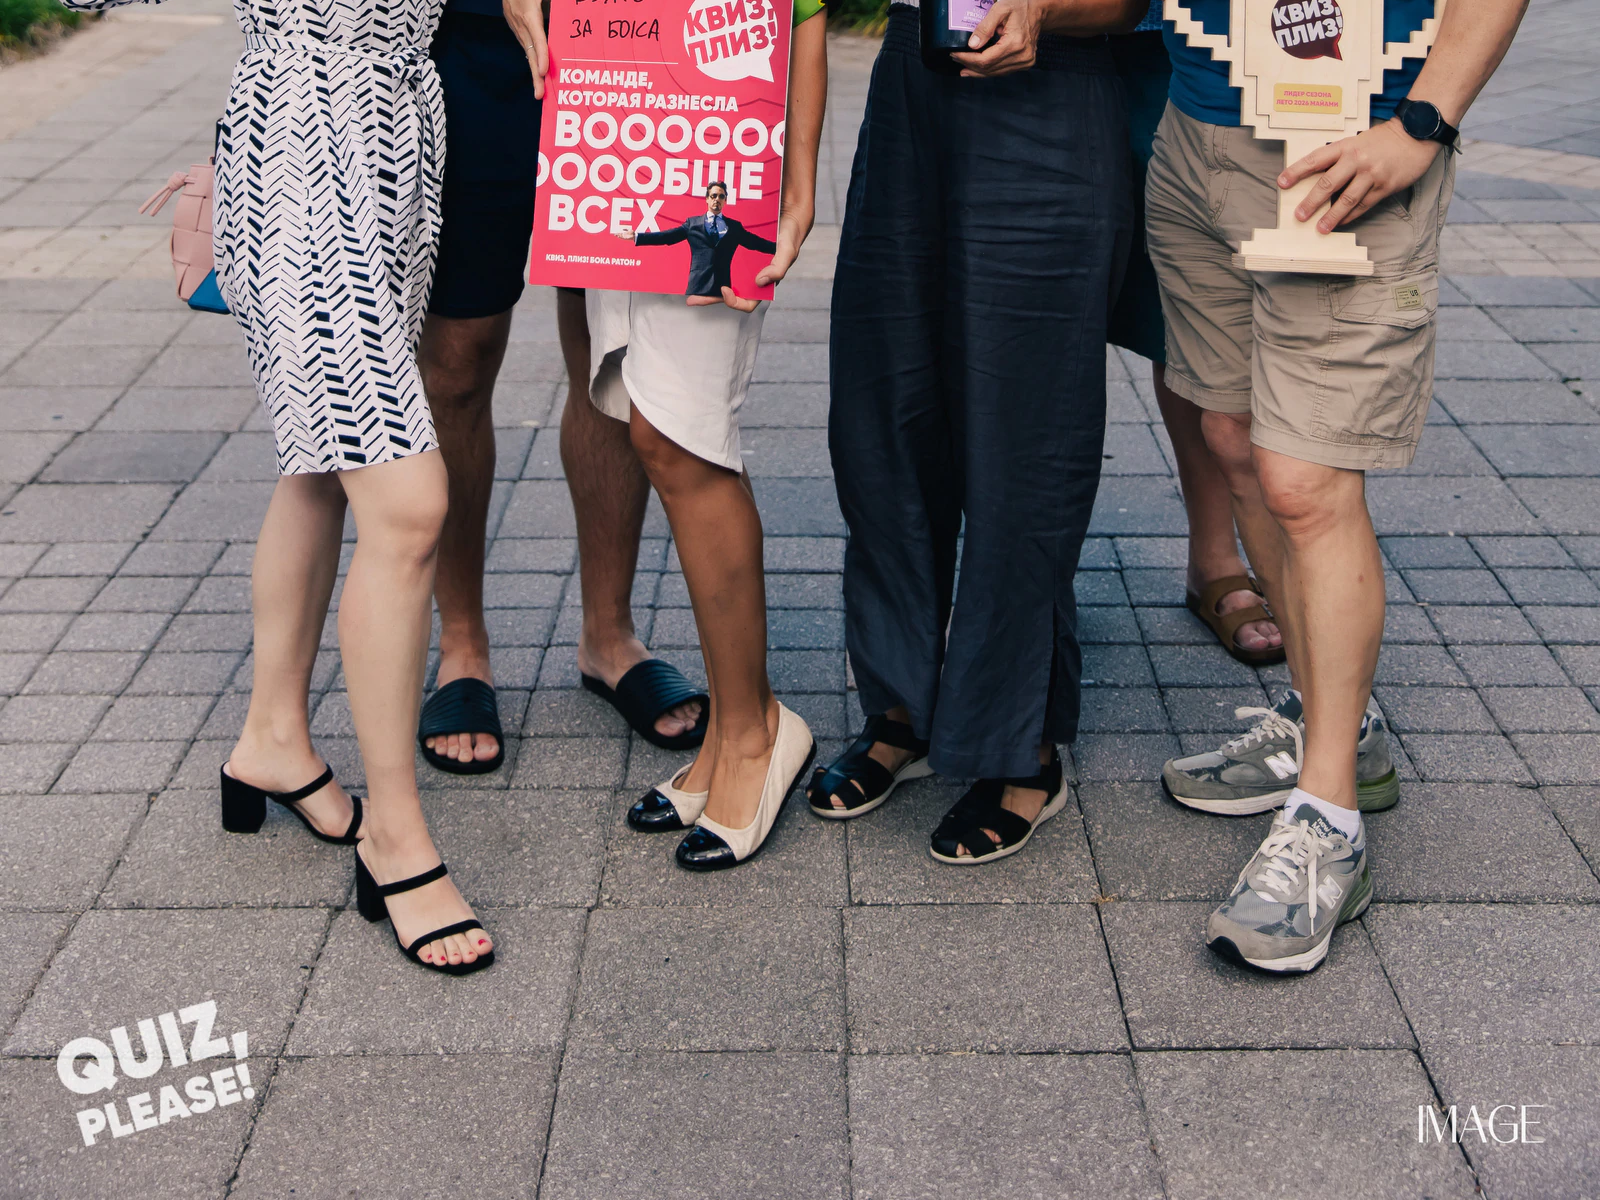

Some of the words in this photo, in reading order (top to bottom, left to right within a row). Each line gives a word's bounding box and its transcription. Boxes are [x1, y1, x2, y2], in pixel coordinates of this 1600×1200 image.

[570, 18, 592, 39] ЗА
[608, 18, 660, 41] БОКА
[1275, 16, 1343, 48] ПЛИЗ!
[687, 21, 777, 66] ПЛИЗ!
[559, 68, 653, 90] КОМАНДЕ,
[557, 90, 641, 108] КОТОРАЯ
[645, 93, 739, 112] РАЗНЕСЛА
[548, 193, 664, 234] ВСЕХ
[545, 253, 566, 263] КВИЗ,
[567, 255, 589, 263] ПЛИЗ!
[590, 256, 610, 265] БОКА
[611, 258, 635, 266] РАТОН
